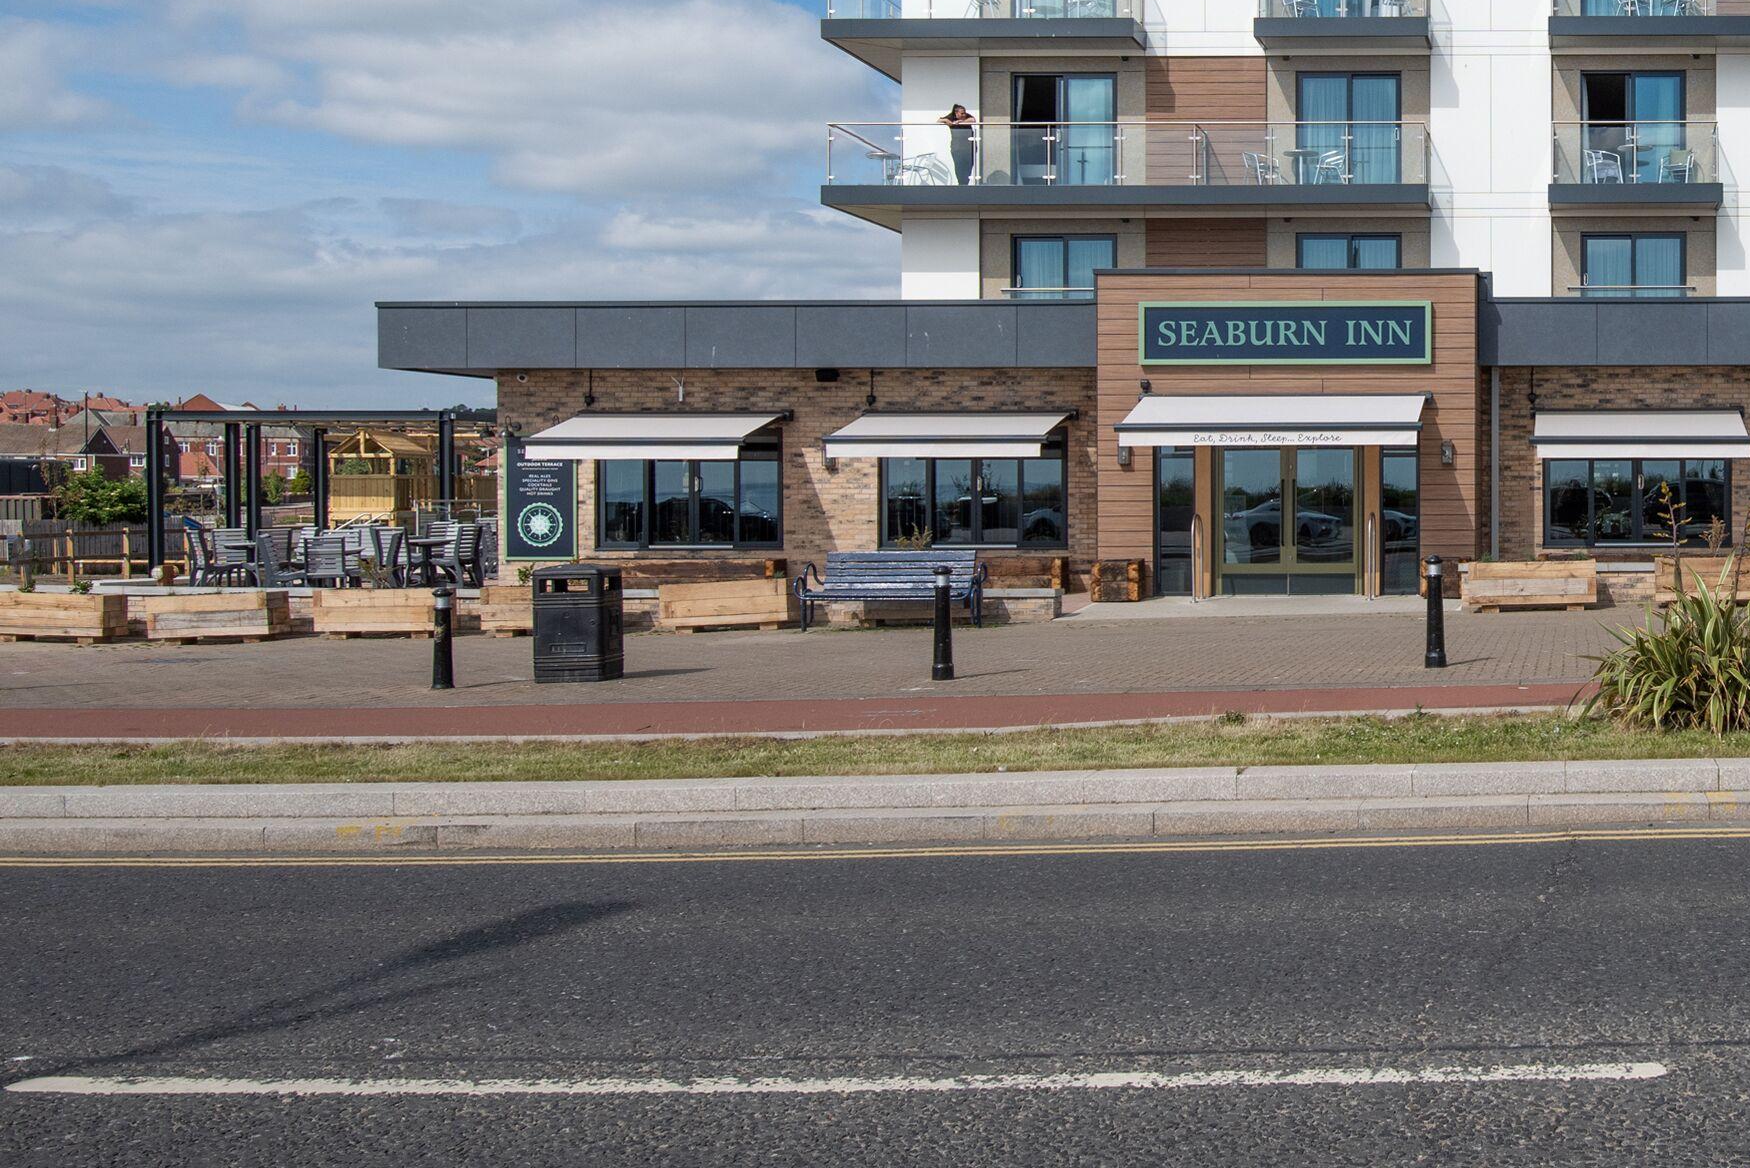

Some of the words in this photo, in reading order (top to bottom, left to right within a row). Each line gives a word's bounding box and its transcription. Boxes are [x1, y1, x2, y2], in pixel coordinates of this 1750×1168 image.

[1157, 320, 1328, 346] SEABURN
[1345, 320, 1413, 346] INN
[1193, 433, 1216, 444] Eat,
[1218, 433, 1258, 444] Drink,
[1297, 433, 1343, 444] Explore
